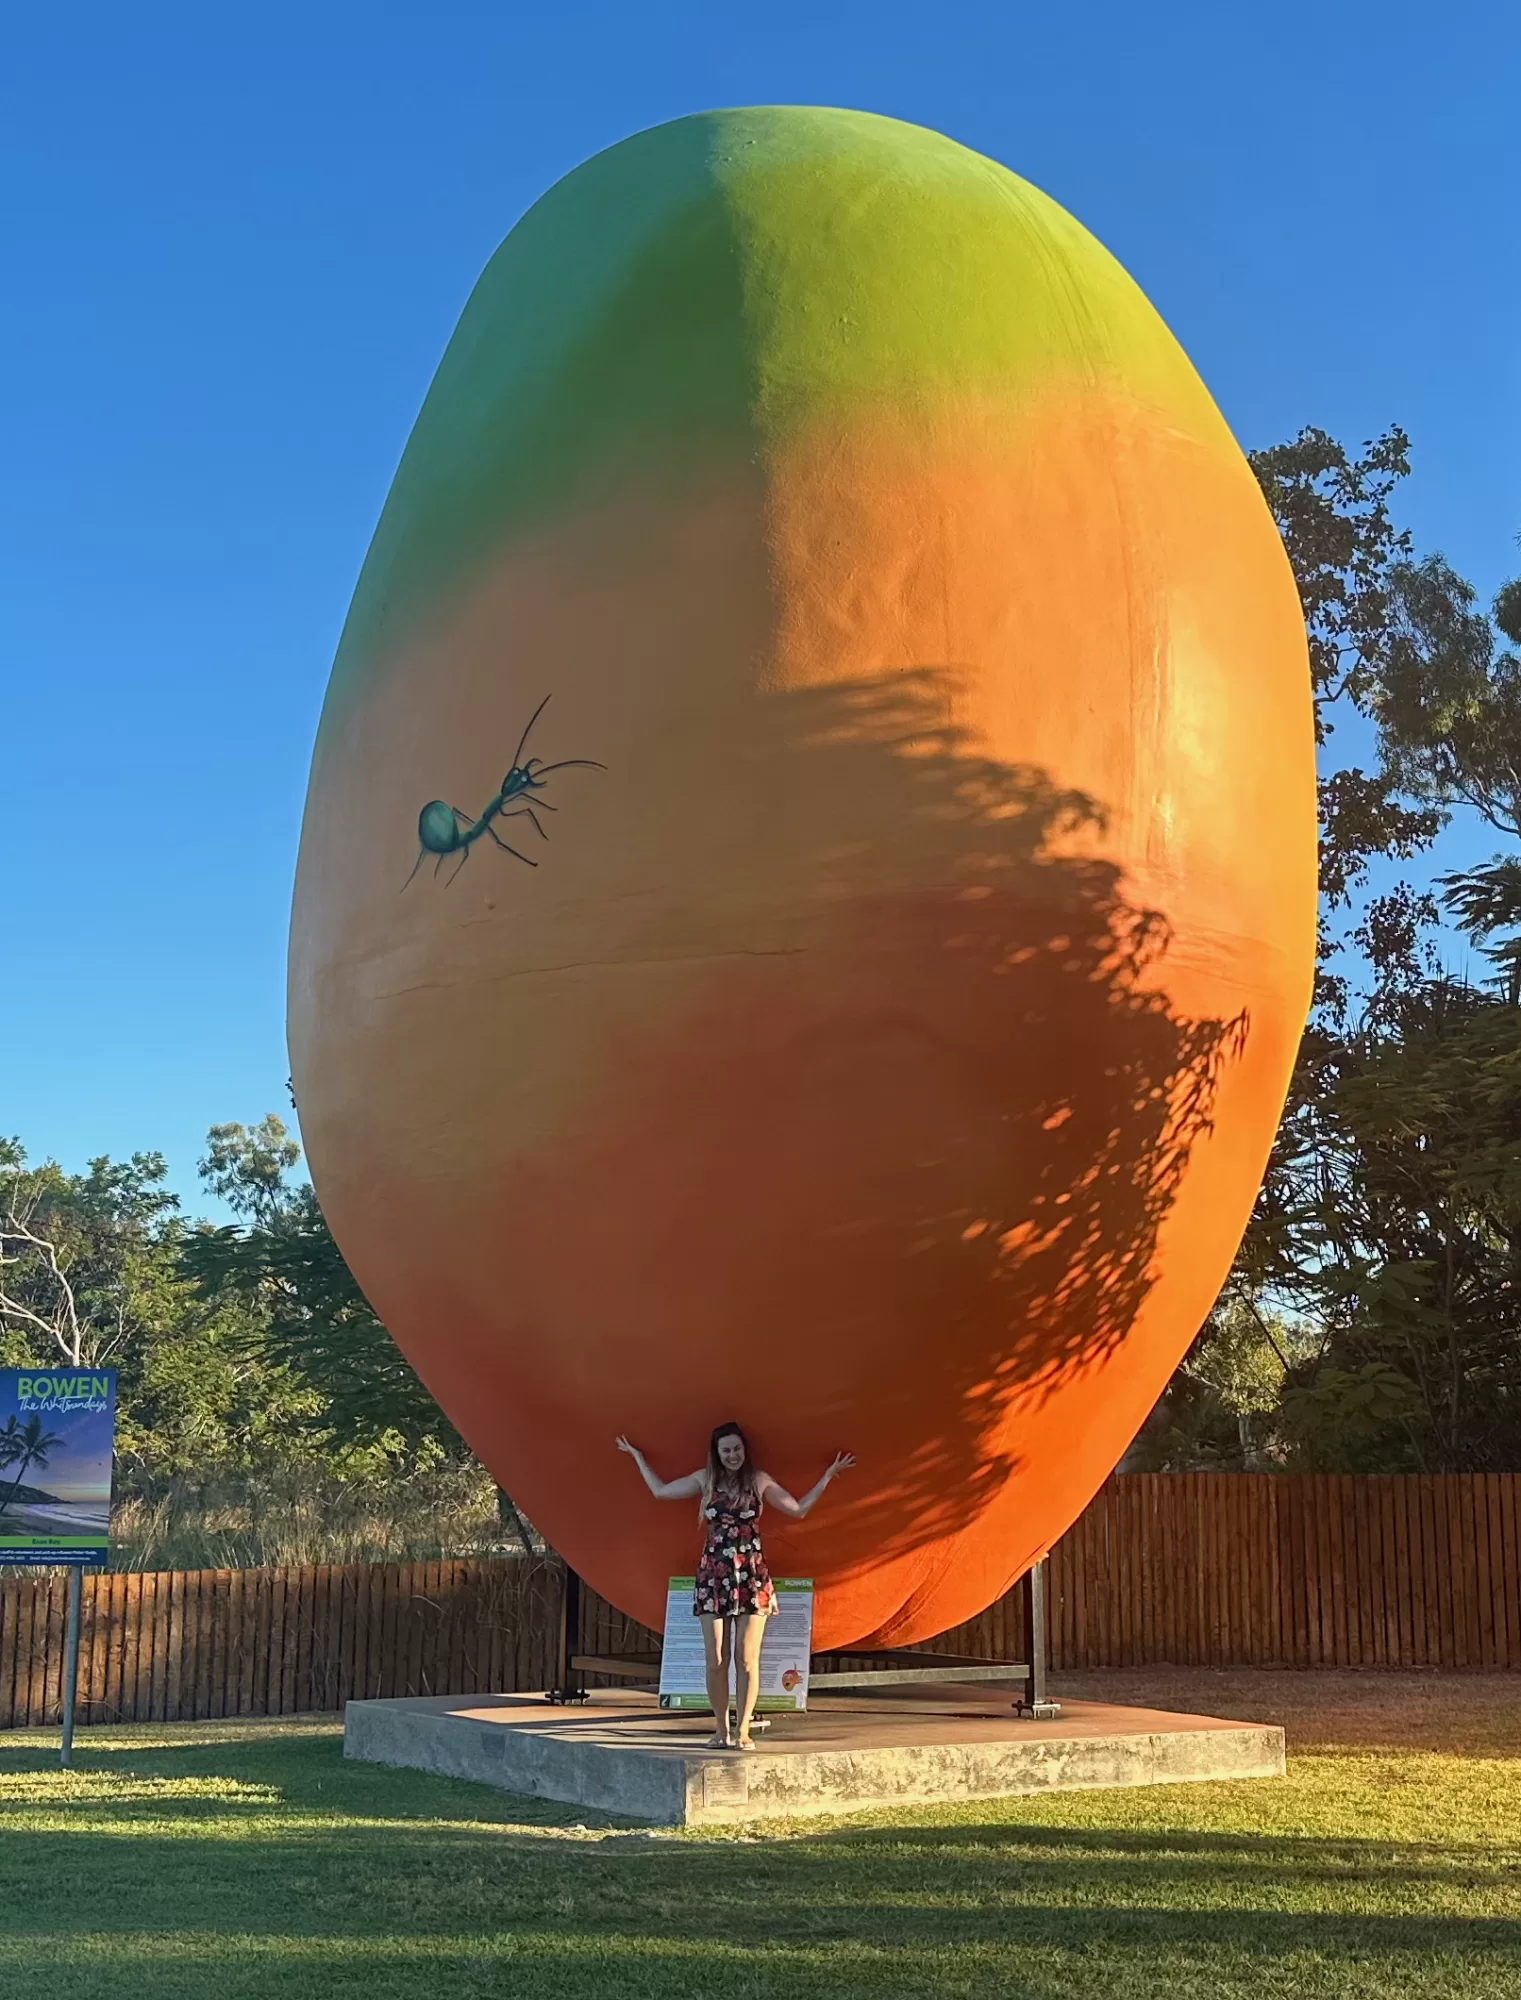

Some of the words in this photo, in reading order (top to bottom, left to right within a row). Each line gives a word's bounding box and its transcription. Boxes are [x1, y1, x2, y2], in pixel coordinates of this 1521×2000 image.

[18, 1377, 109, 1398] BOWEN
[18, 1396, 39, 1411] The
[40, 1395, 107, 1413] Whitsundays
